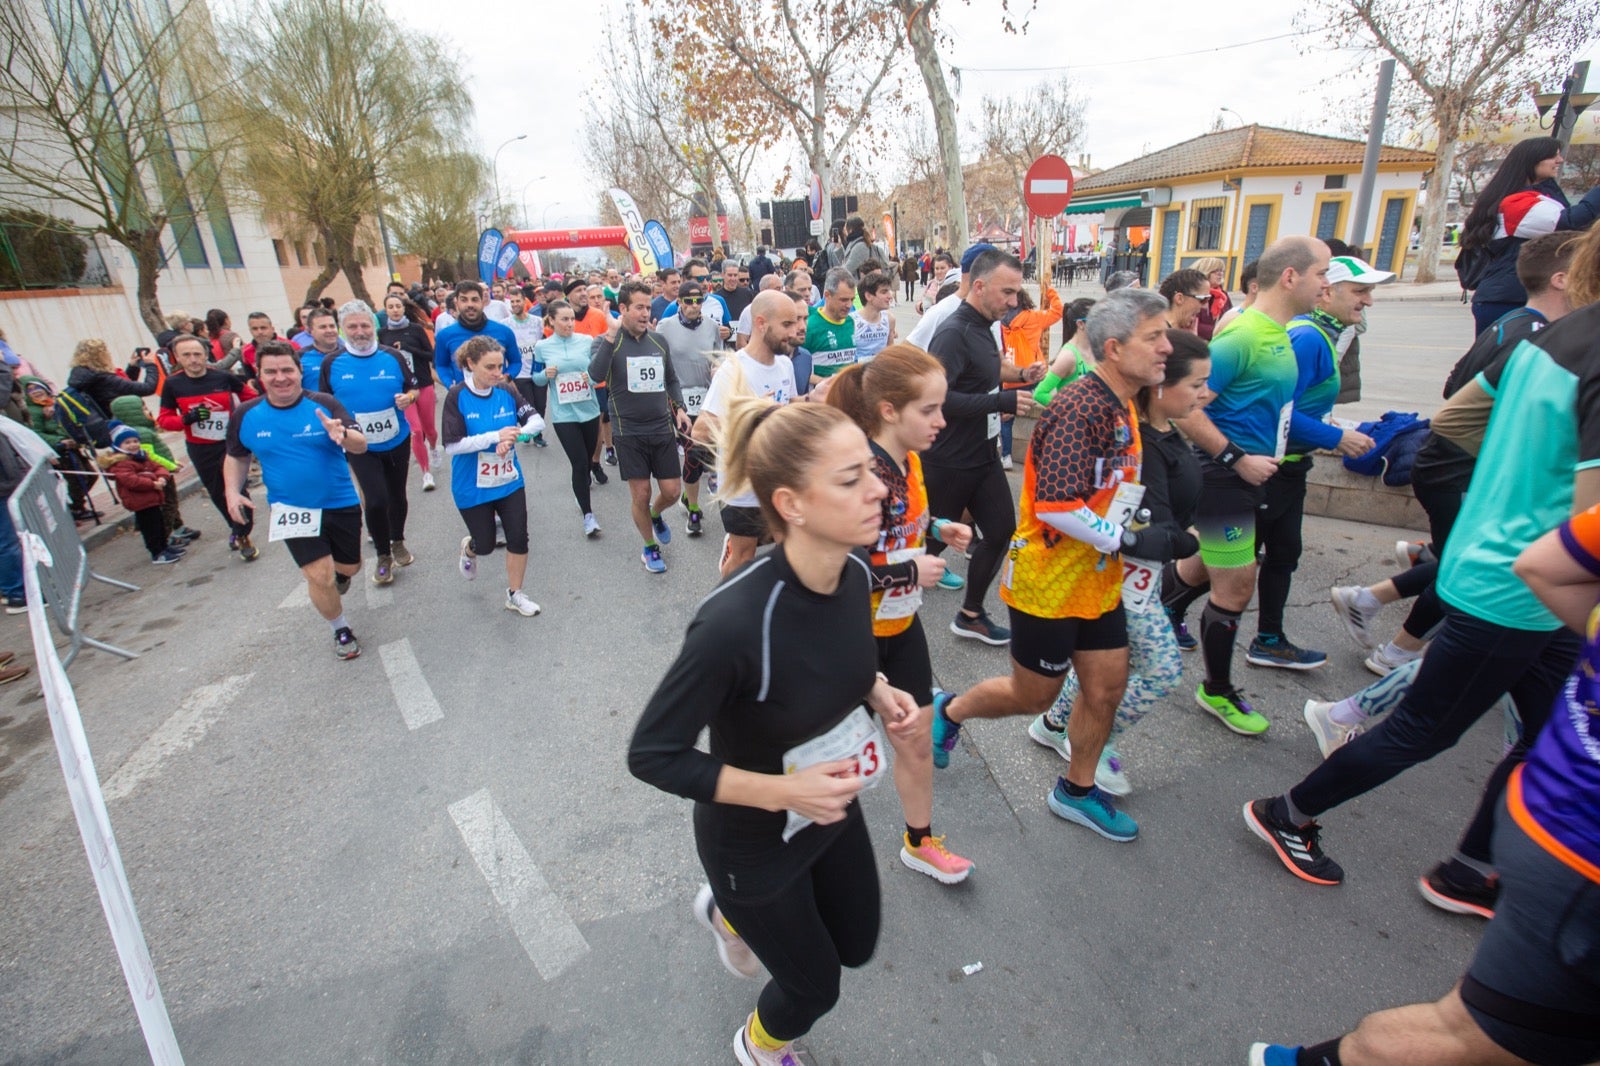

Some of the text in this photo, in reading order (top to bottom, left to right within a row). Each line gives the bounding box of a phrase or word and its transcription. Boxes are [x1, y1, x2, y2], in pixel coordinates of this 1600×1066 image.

[640, 367, 656, 381] 59
[560, 381, 588, 393] 2054
[689, 395, 701, 406] 52
[366, 419, 392, 433] 494
[481, 460, 513, 476] 2113
[278, 512, 311, 525] 498
